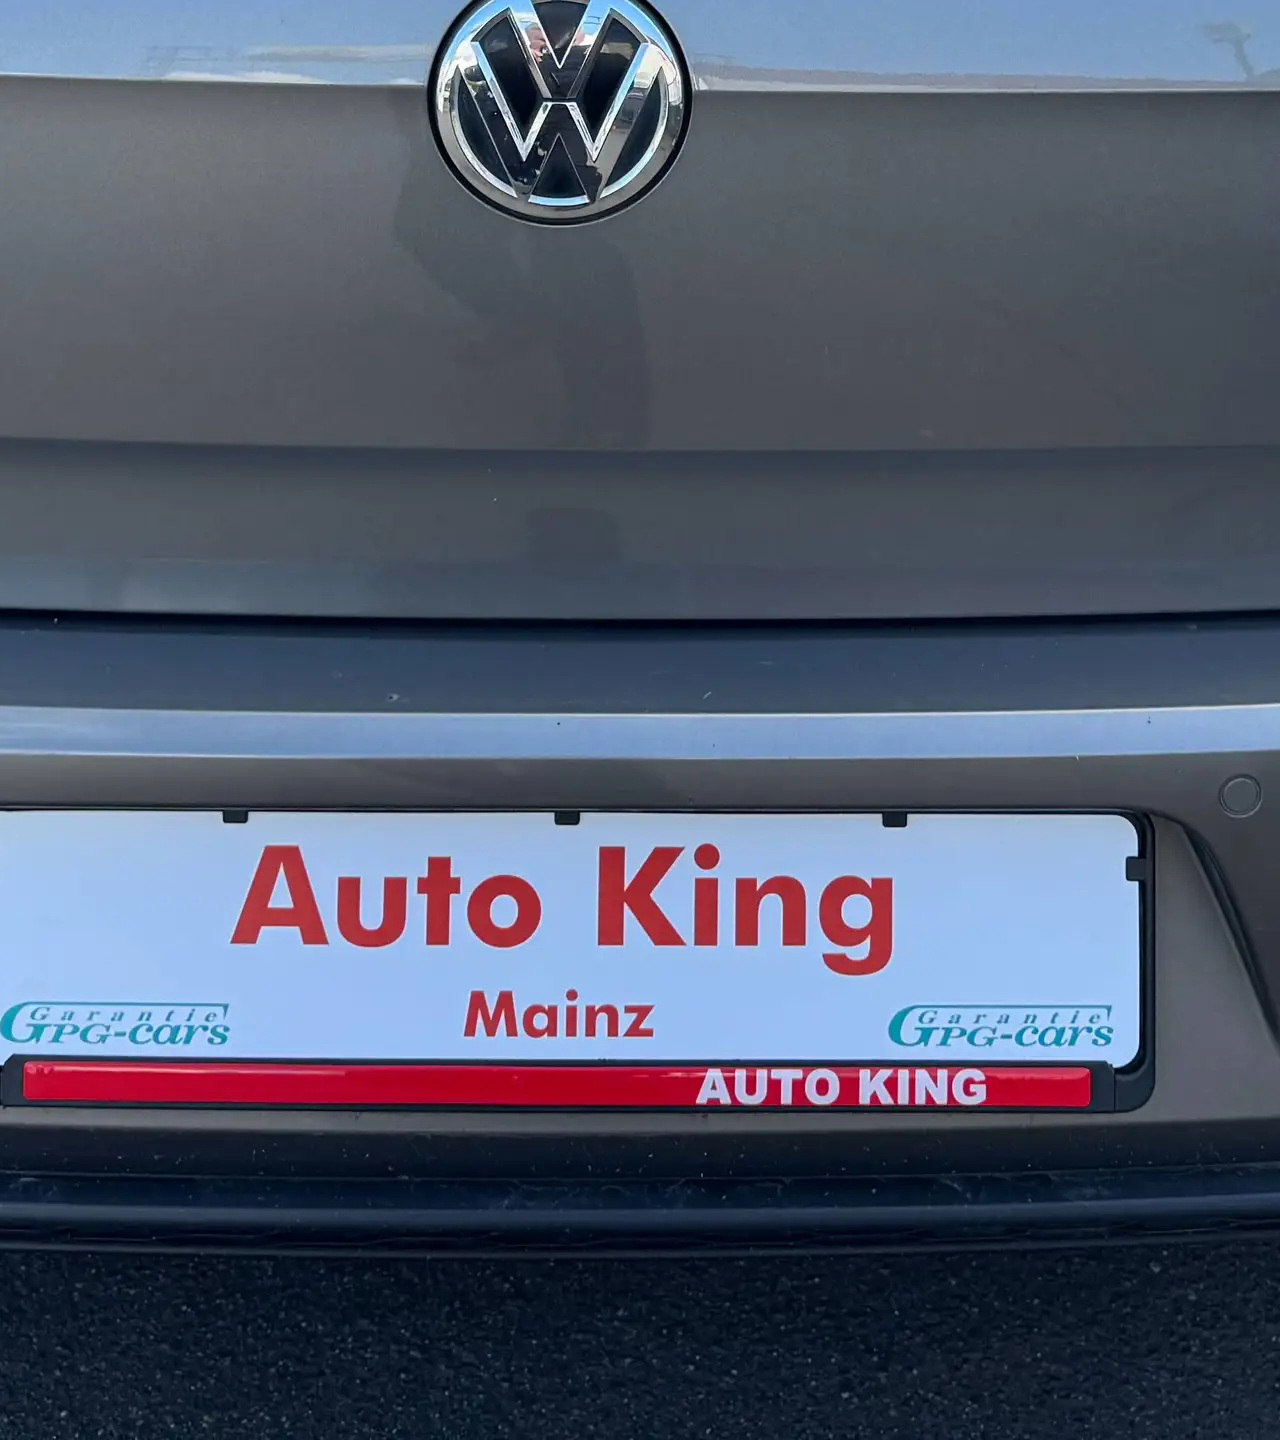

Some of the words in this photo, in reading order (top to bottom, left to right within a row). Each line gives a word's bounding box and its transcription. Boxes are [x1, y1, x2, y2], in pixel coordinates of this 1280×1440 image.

[230, 844, 542, 949] Auto
[596, 842, 894, 977] King
[30, 1006, 218, 1023] Garantie
[463, 988, 656, 1039] Mainz
[918, 1009, 1102, 1025] Garantie
[695, 1068, 840, 1106] AUTO
[859, 1068, 987, 1106] KING
